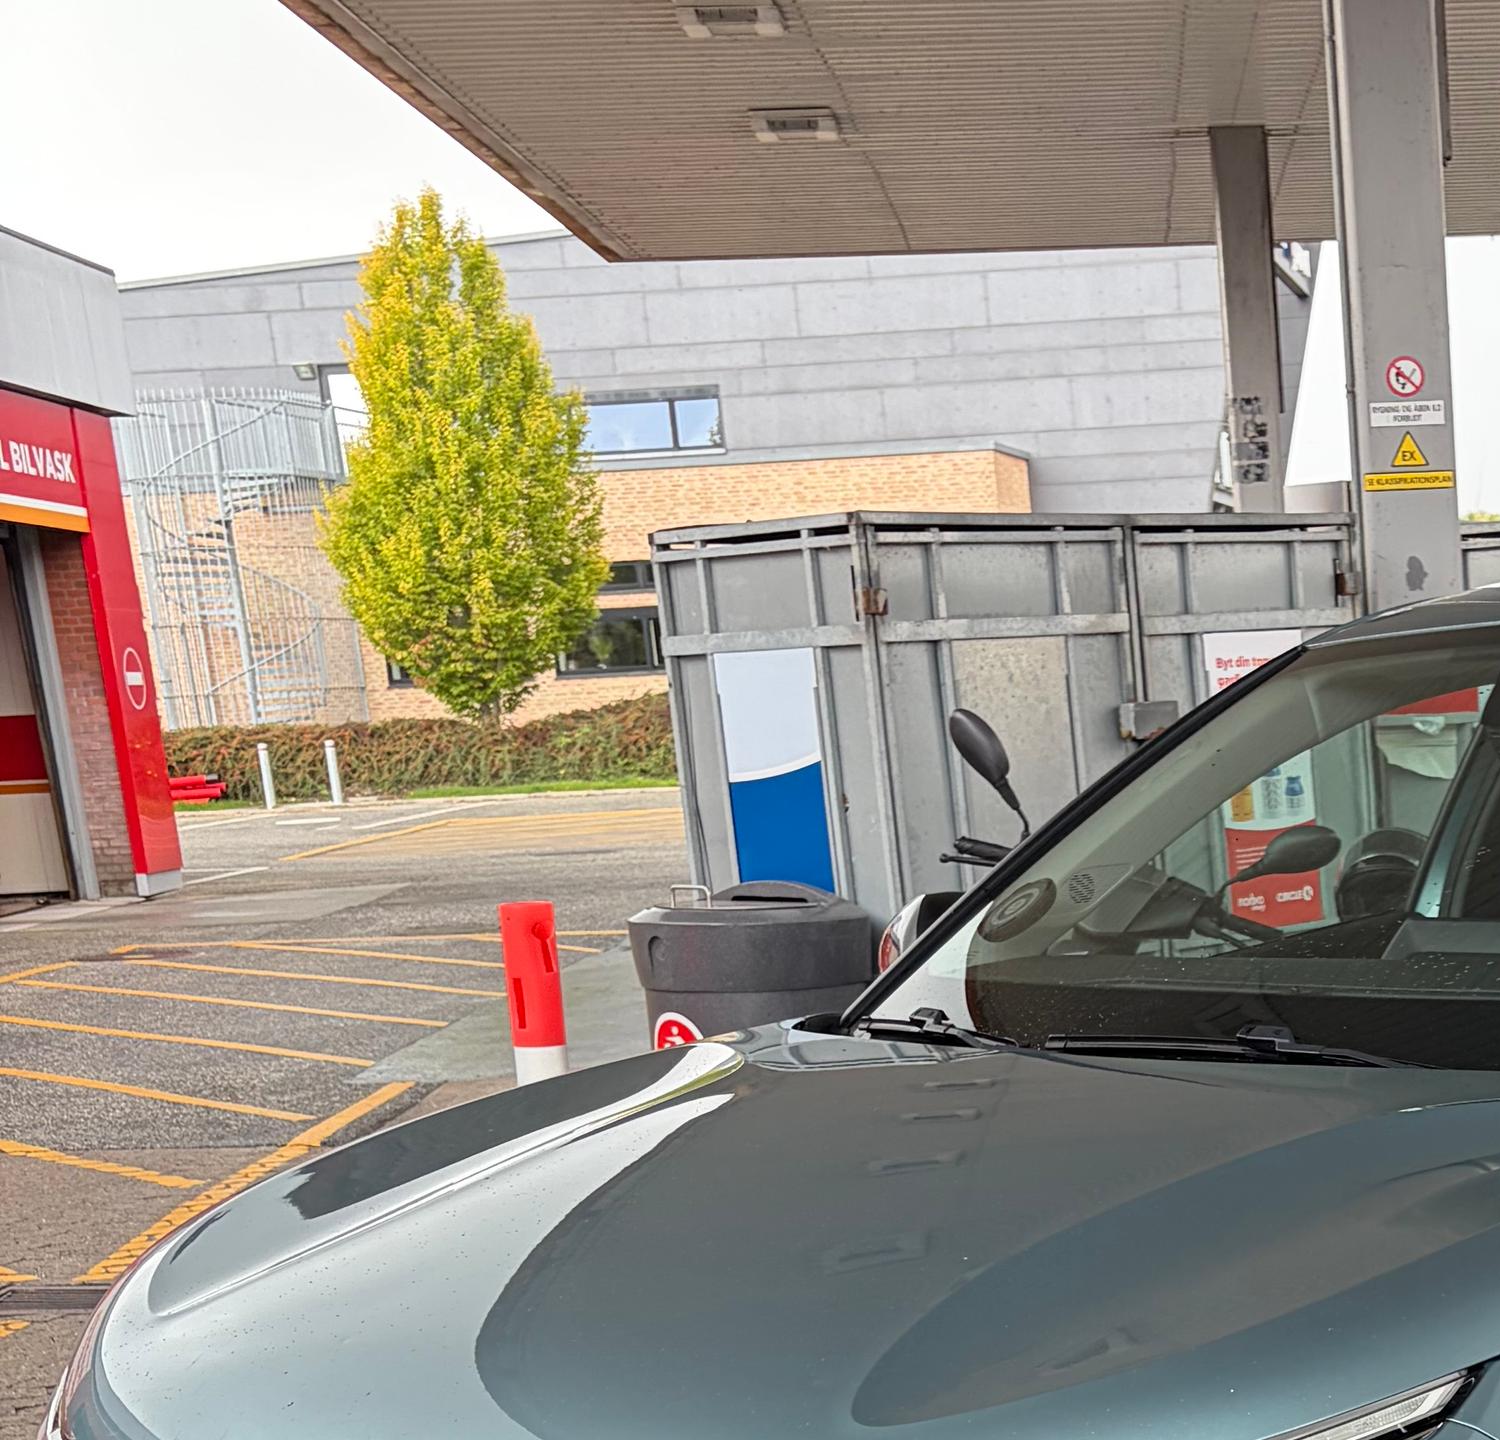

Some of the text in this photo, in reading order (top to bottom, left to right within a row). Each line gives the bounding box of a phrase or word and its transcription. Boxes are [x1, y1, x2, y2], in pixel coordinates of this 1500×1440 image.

[9, 440, 76, 483] BILVASK
[1402, 451, 1417, 461] EX
[1215, 657, 1233, 671] Byt
[1235, 656, 1249, 668] din
